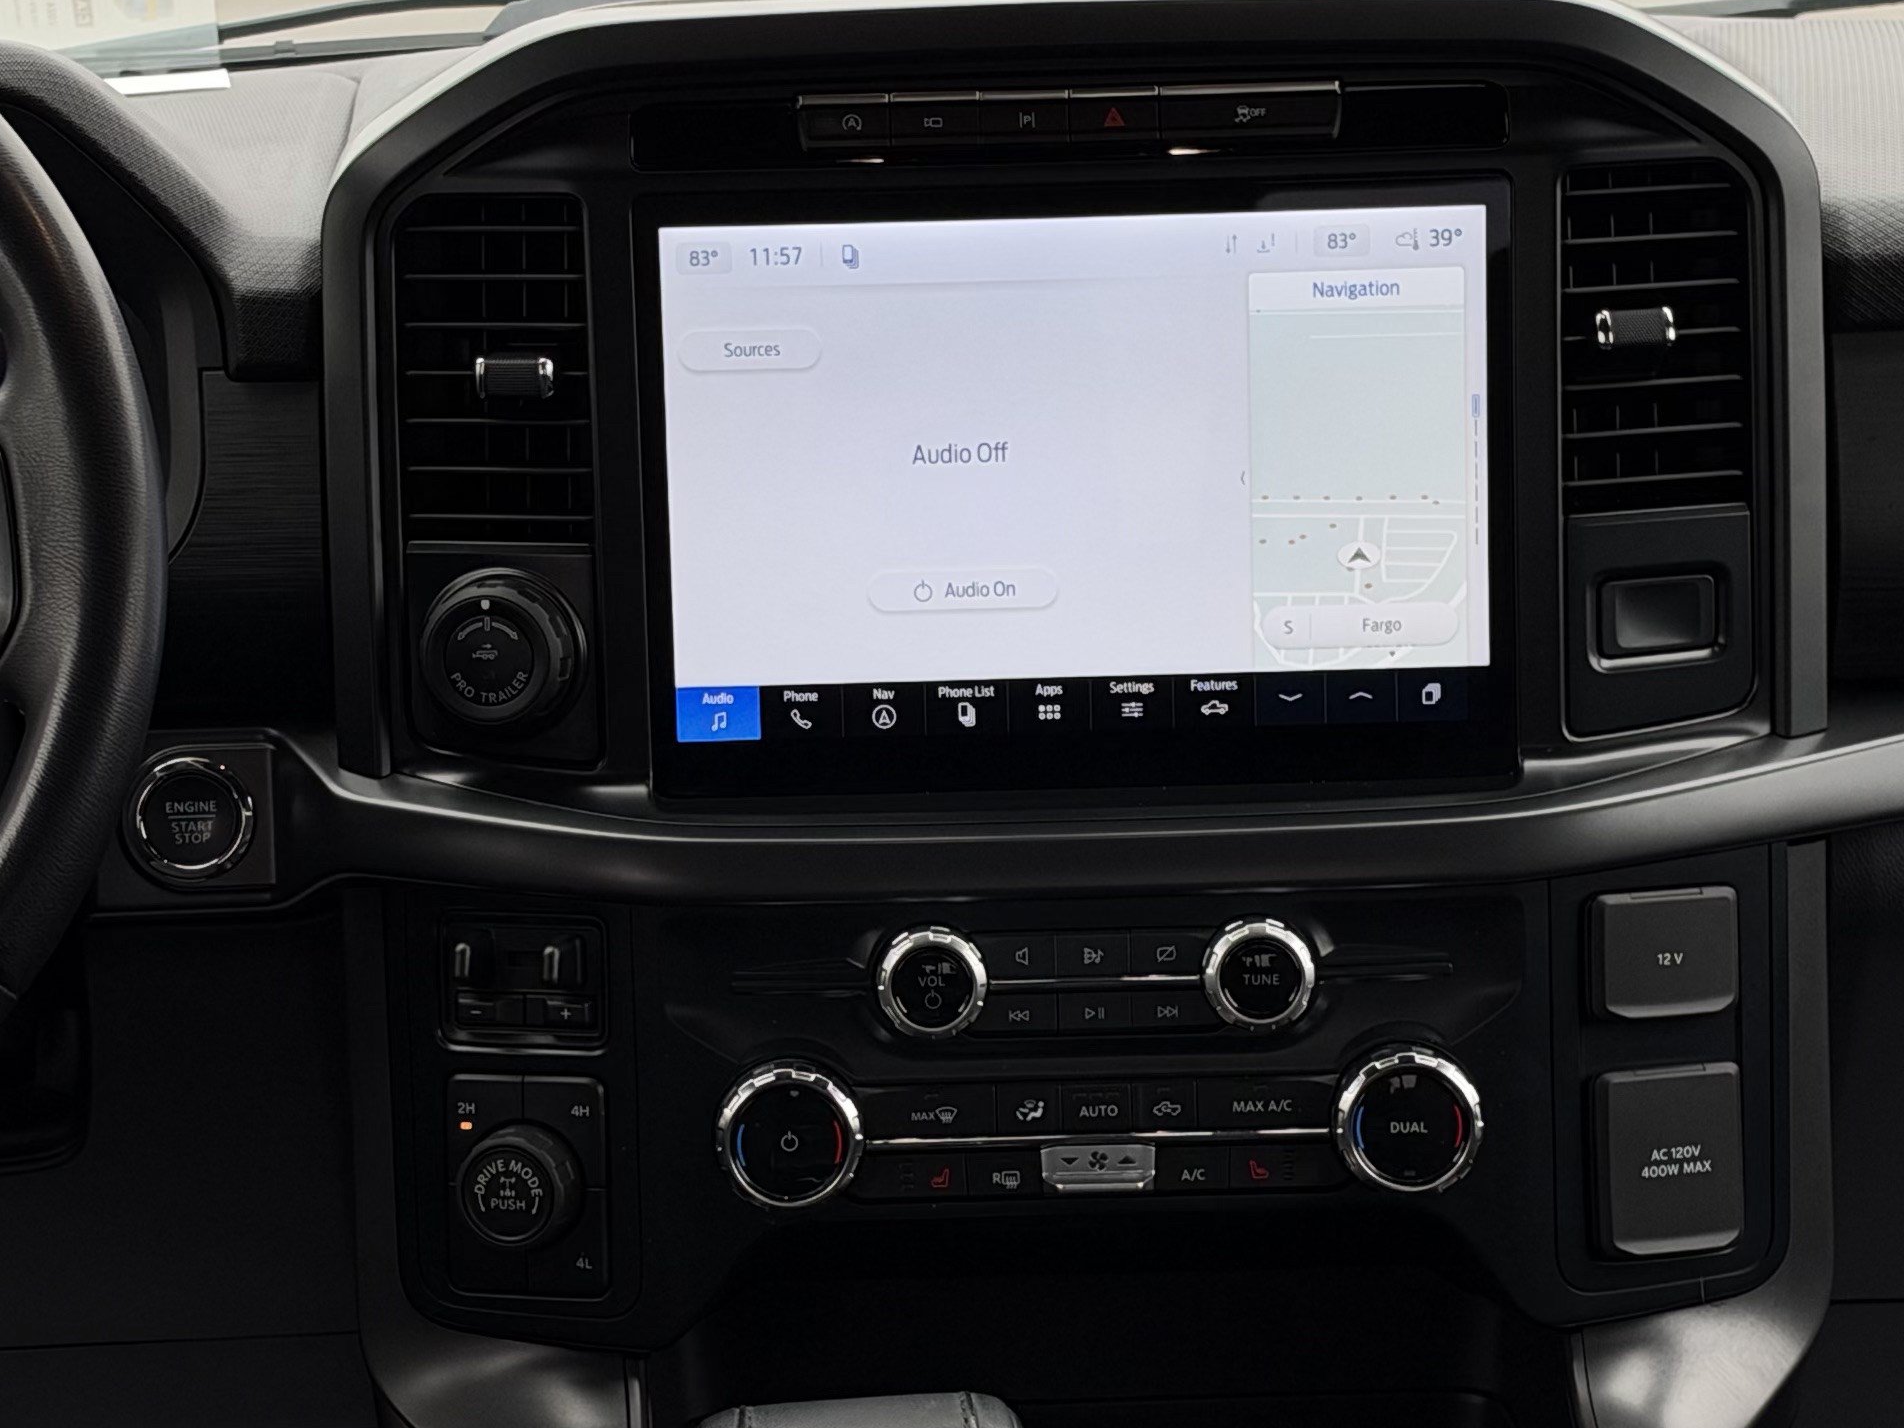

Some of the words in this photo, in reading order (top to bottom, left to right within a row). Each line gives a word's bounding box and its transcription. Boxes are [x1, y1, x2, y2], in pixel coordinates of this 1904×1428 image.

[1249, 107, 1267, 118] OFF
[1327, 231, 1357, 251] 83°
[1429, 227, 1463, 248] 39°
[690, 248, 719, 267] 83°
[750, 245, 803, 267] 11:57
[1312, 278, 1400, 302] Navigation
[724, 341, 781, 360] Sources
[912, 443, 972, 466] Audio
[977, 441, 1008, 464] Off
[945, 580, 990, 600] Audio
[995, 580, 1016, 598] On
[1362, 616, 1402, 637] Fargo
[450, 671, 476, 699] PRO
[479, 669, 529, 705] TRAILER
[938, 685, 972, 699] Phone
[976, 684, 995, 698] List
[1035, 683, 1063, 700] Apps
[1109, 680, 1155, 697] Settings
[1190, 677, 1238, 692] Features
[702, 691, 735, 706] Audio
[783, 689, 819, 704] Phone
[873, 687, 895, 701] Nav
[165, 801, 217, 814] ENGINE
[171, 820, 214, 833] START
[174, 832, 212, 845] STOP
[1657, 953, 1672, 966] 12
[1672, 952, 1684, 965] V
[918, 975, 946, 988] VOL
[1243, 973, 1280, 985] TUNE
[457, 1102, 476, 1115] 2H
[570, 1104, 590, 1117] 4H
[1079, 1104, 1119, 1118] AUTO
[1232, 1100, 1264, 1114] MAX
[1267, 1098, 1293, 1114] A/C
[911, 1110, 936, 1123] MAX
[1390, 1121, 1428, 1134] DUAL
[1650, 1147, 1669, 1162] AC
[1671, 1144, 1702, 1160] 120V
[1180, 1168, 1207, 1184] A/C
[1641, 1164, 1680, 1180] 400W
[1683, 1160, 1713, 1176] MAX
[473, 1159, 507, 1196] DRIVE
[508, 1160, 544, 1198] MODE
[490, 1198, 526, 1211] PUSH
[576, 1257, 592, 1270] 4L
